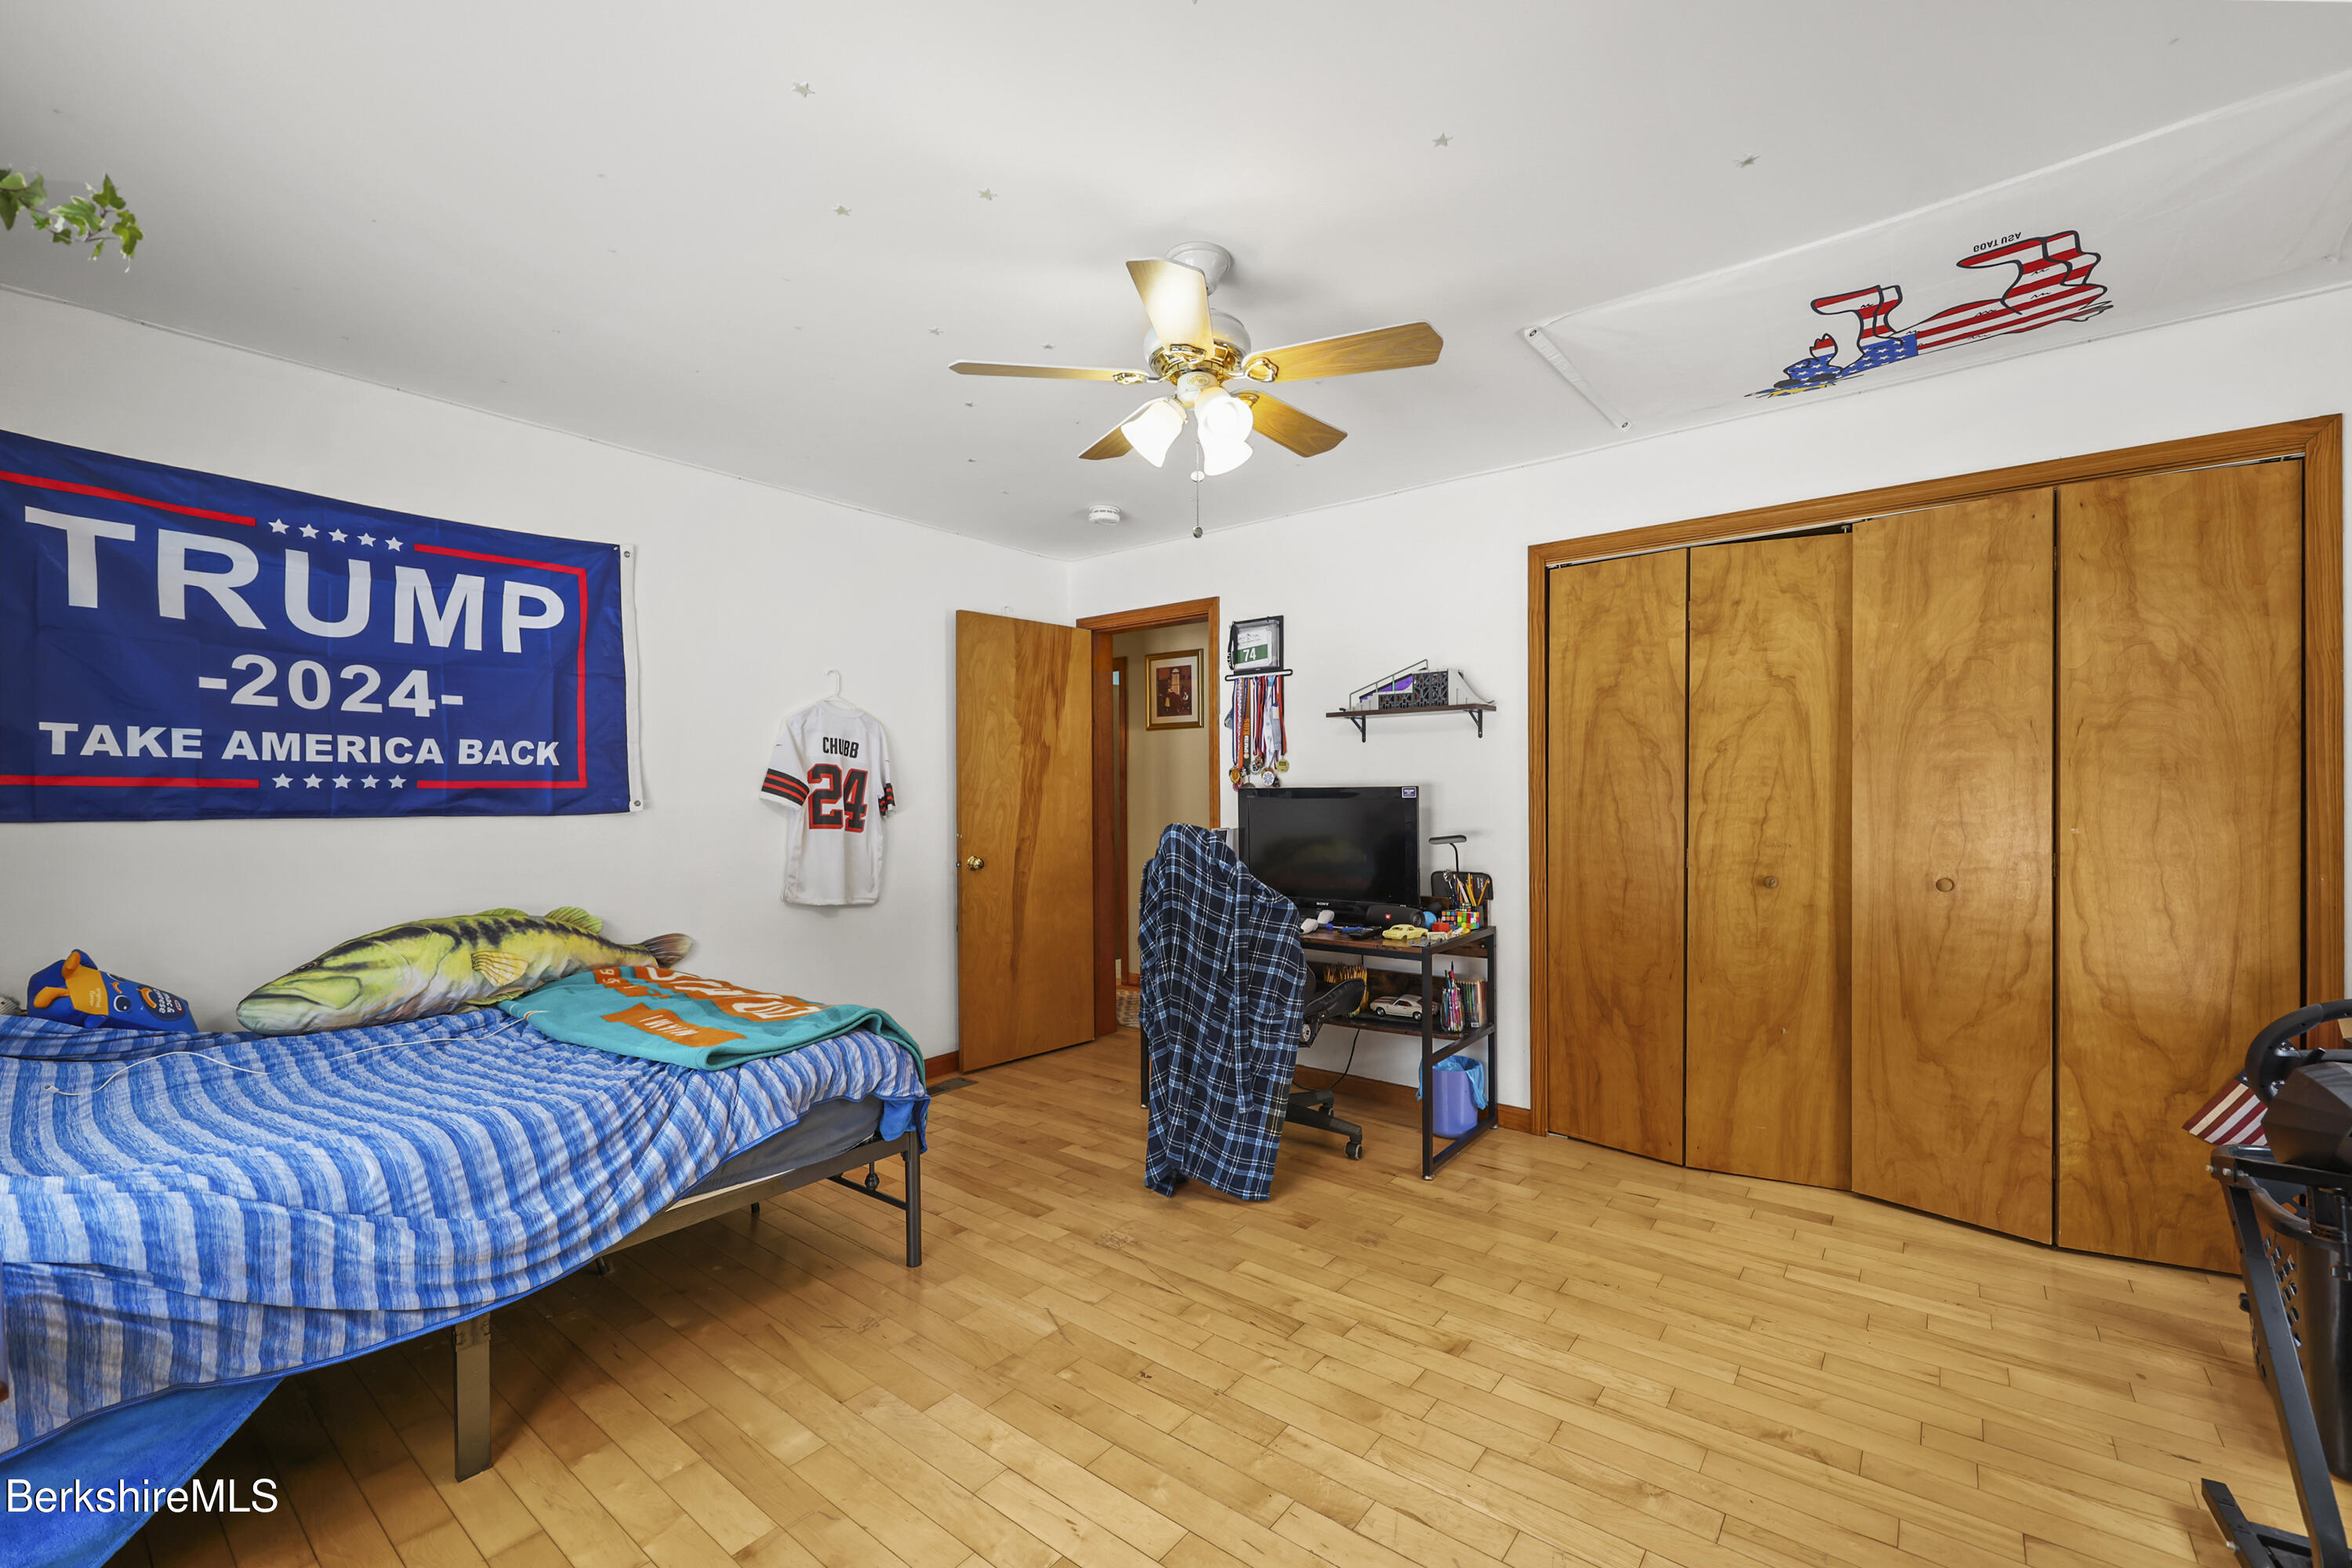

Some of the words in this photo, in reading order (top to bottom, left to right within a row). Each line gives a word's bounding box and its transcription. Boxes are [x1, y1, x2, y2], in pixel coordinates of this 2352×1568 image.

[25, 506, 565, 654] TRUMP
[1243, 647, 1257, 662] 74
[198, 654, 464, 718] -2024-
[39, 722, 203, 760] TAKE
[222, 731, 445, 765] AMERICA
[459, 738, 560, 767] BACK
[822, 736, 859, 759] CHUBB
[807, 763, 869, 833] 24
